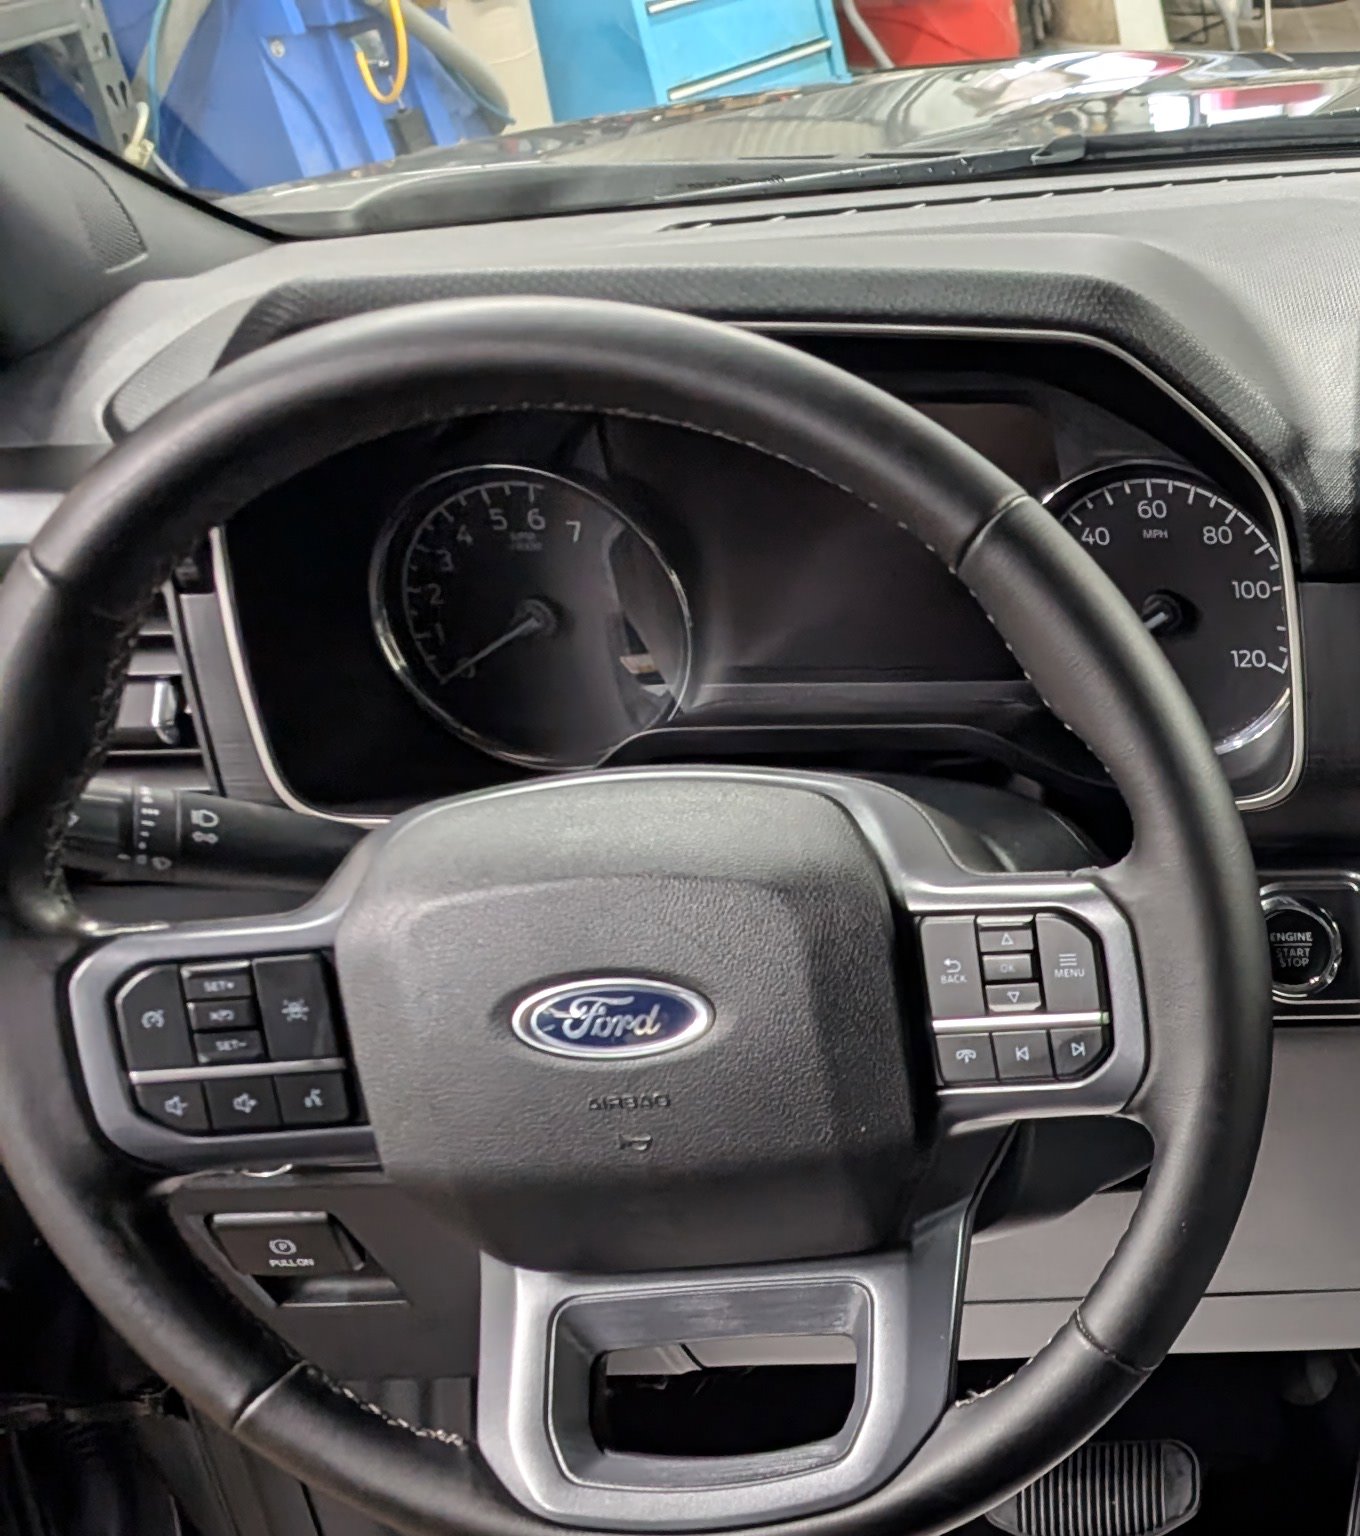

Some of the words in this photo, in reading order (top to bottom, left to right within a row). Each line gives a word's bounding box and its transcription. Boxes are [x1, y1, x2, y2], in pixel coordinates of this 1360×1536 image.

[1137, 500, 1167, 518] 60
[489, 508, 508, 530] 5
[527, 508, 546, 530] 6
[565, 520, 581, 543] 7
[1081, 527, 1110, 546] 40
[1143, 529, 1168, 539] MPH
[1203, 525, 1232, 545] 80
[1231, 580, 1271, 599] 100
[1230, 650, 1266, 668] 120
[1270, 932, 1313, 942] ENGINE
[1000, 964, 1015, 973] OK
[1280, 958, 1310, 968] STOP
[941, 975, 967, 984] BACK
[1054, 968, 1085, 978] MENU
[561, 995, 662, 1040] Ford
[269, 1259, 294, 1267] PULL
[296, 1258, 314, 1267] ON
